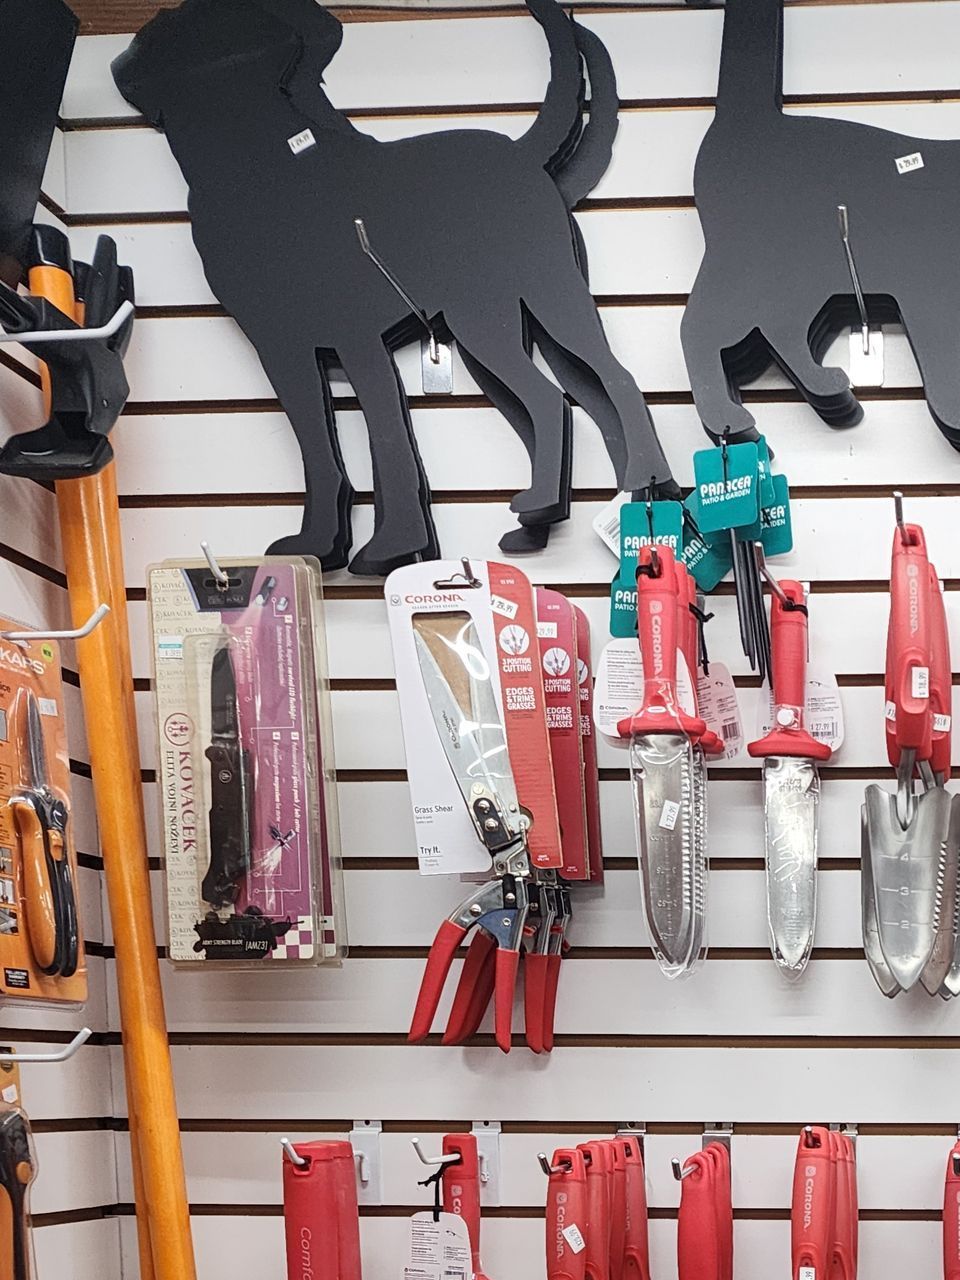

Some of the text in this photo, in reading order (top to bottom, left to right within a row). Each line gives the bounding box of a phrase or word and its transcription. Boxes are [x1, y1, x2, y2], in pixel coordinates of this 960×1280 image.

[700, 476, 753, 498] PANACEA
[702, 495, 720, 506] PATIO
[725, 488, 751, 501] GARDEN
[405, 594, 463, 604] CORONA
[614, 603, 634, 612] PATIO
[907, 579, 920, 635] CORONA
[651, 615, 665, 676] CORONA
[0, 653, 45, 675] KARS
[507, 657, 532, 666] POSITION
[503, 664, 532, 673] CUTTING
[549, 678, 571, 686] POSITION
[506, 687, 534, 696] EDGES
[545, 684, 572, 693] CUTTING
[507, 701, 536, 711] GRASSES
[546, 706, 572, 715] EDGES
[546, 720, 573, 729] GRASSES
[168, 782, 177, 812] VOJNI
[434, 805, 454, 813] Shear
[420, 847, 432, 855] Try
[900, 852, 910, 861] 4
[900, 886, 910, 896] 3
[900, 920, 910, 929] 2
[804, 1178, 815, 1229] CORONA
[556, 1205, 566, 1259] CORONA
